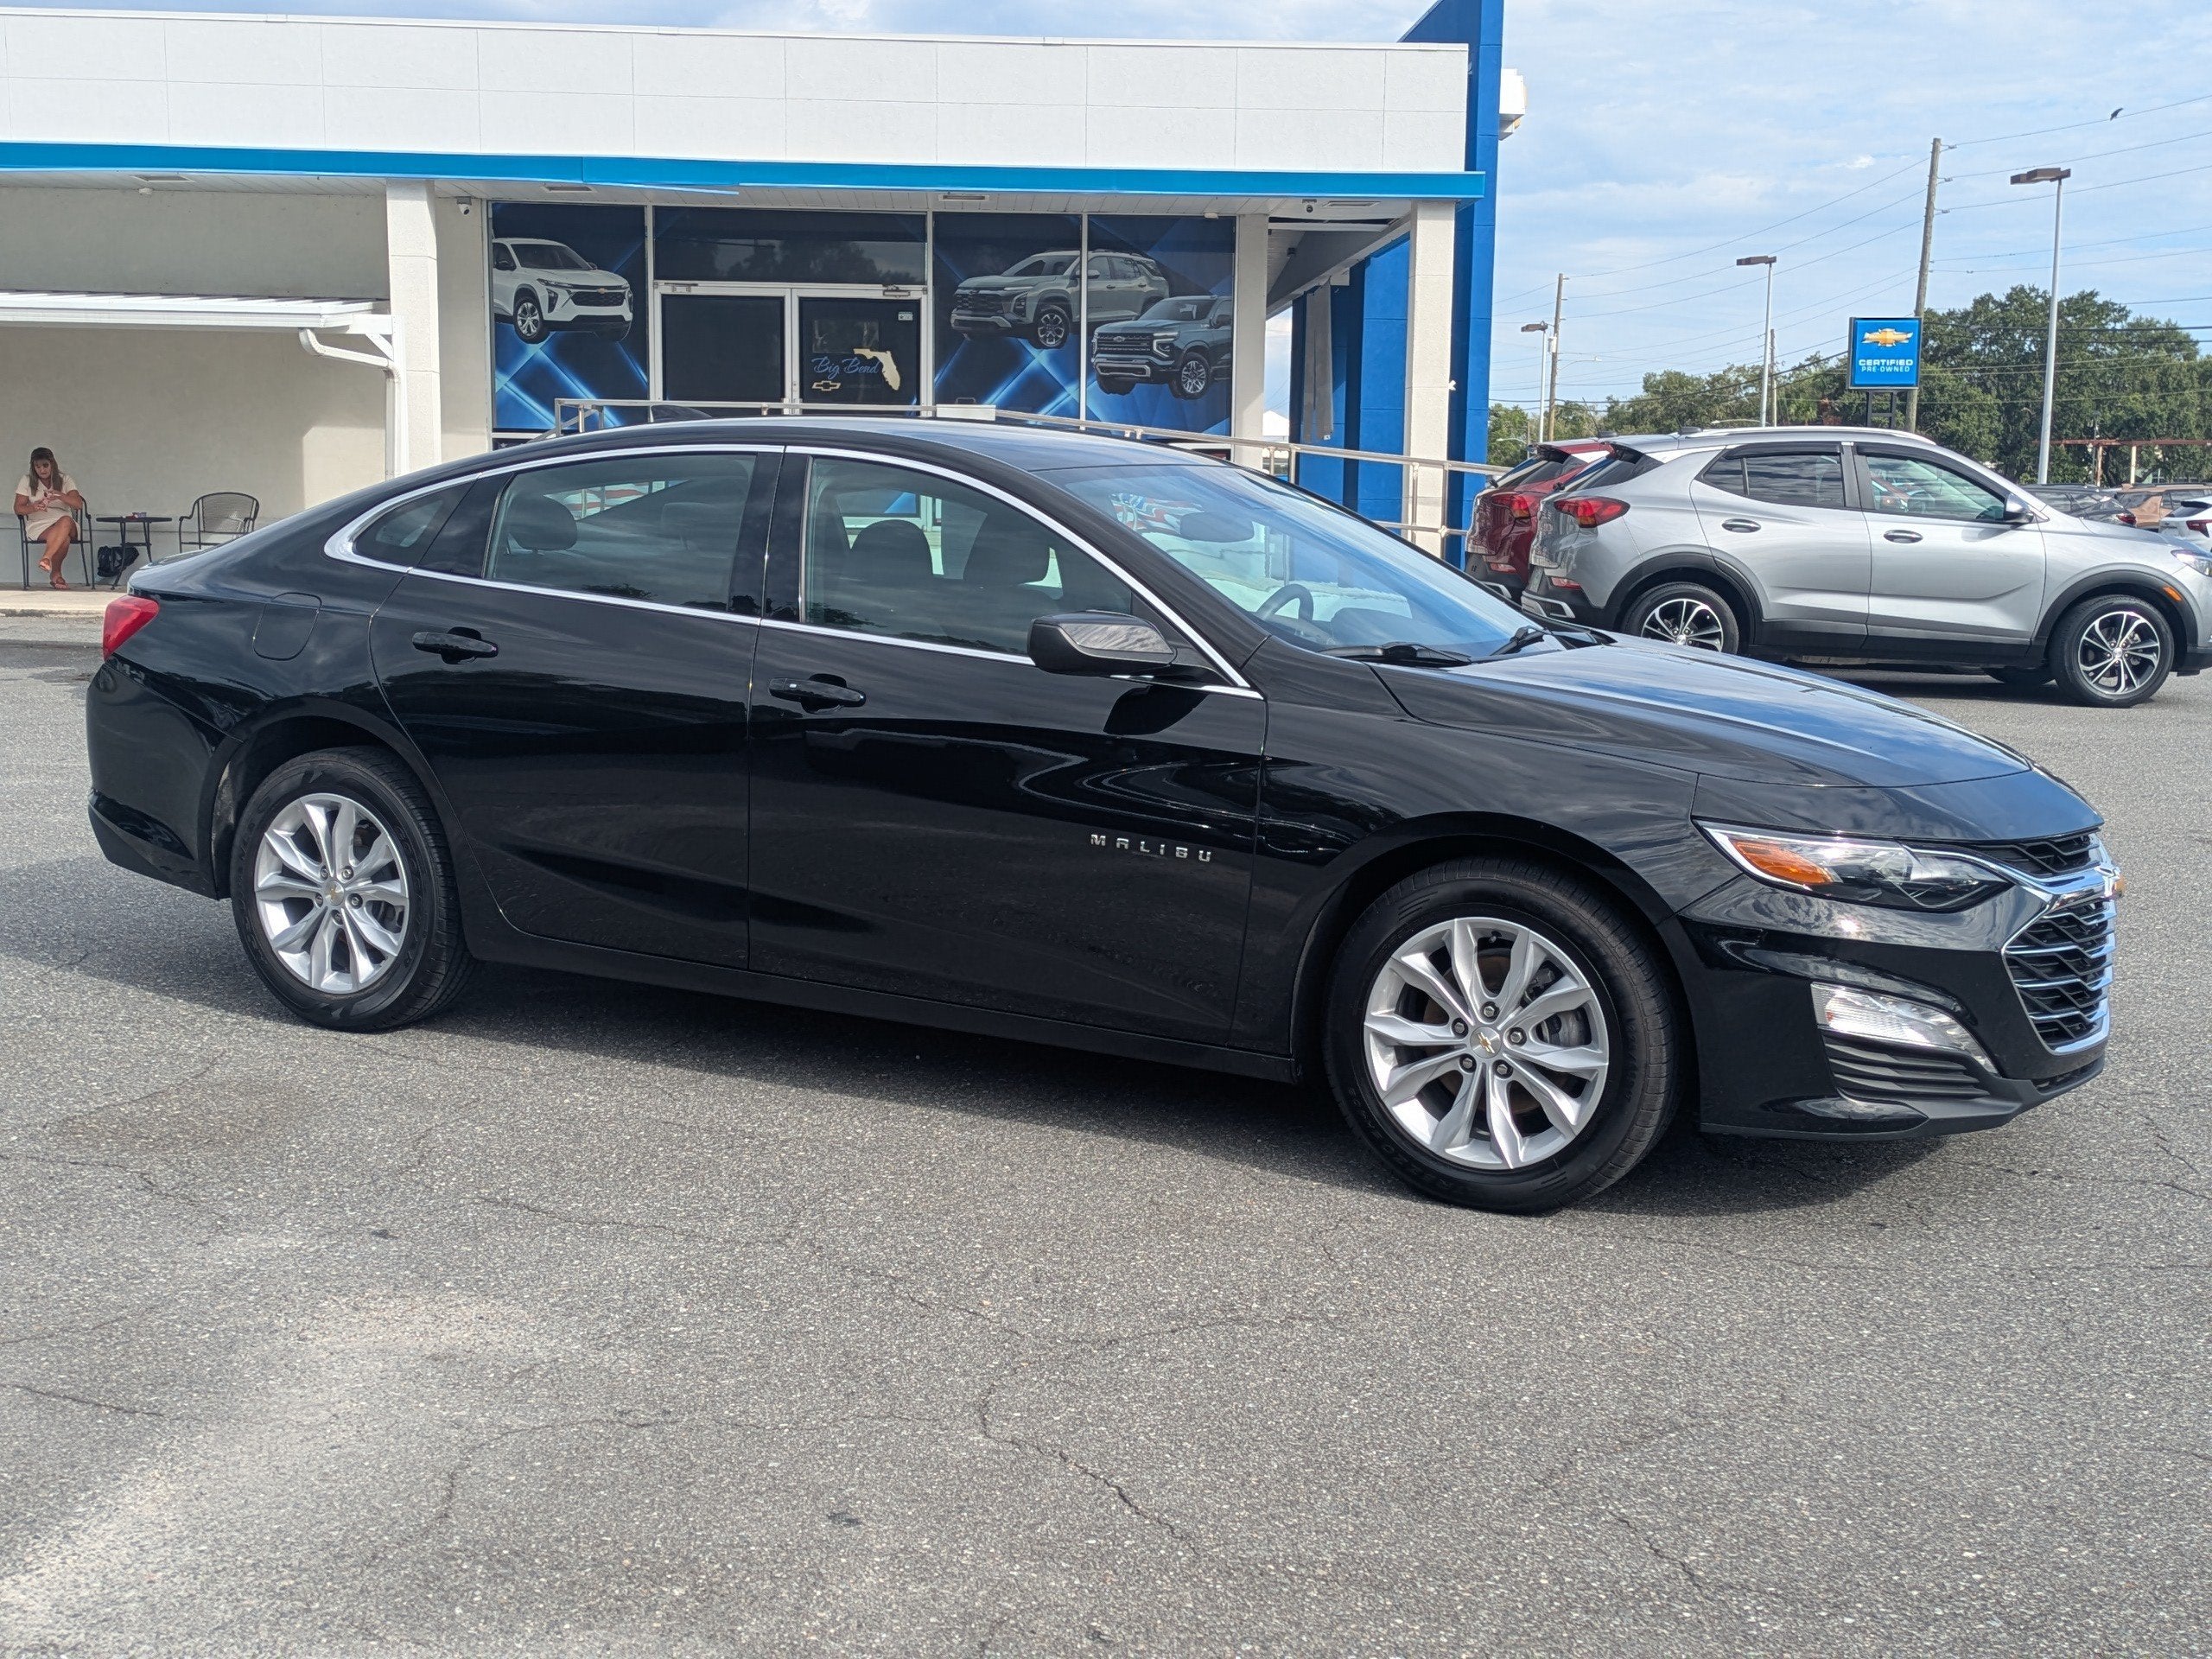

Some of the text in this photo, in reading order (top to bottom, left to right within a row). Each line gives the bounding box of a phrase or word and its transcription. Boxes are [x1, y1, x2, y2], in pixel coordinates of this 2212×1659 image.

[810, 356, 880, 379] Big Bend
[1090, 834, 1211, 862] MALIBU
